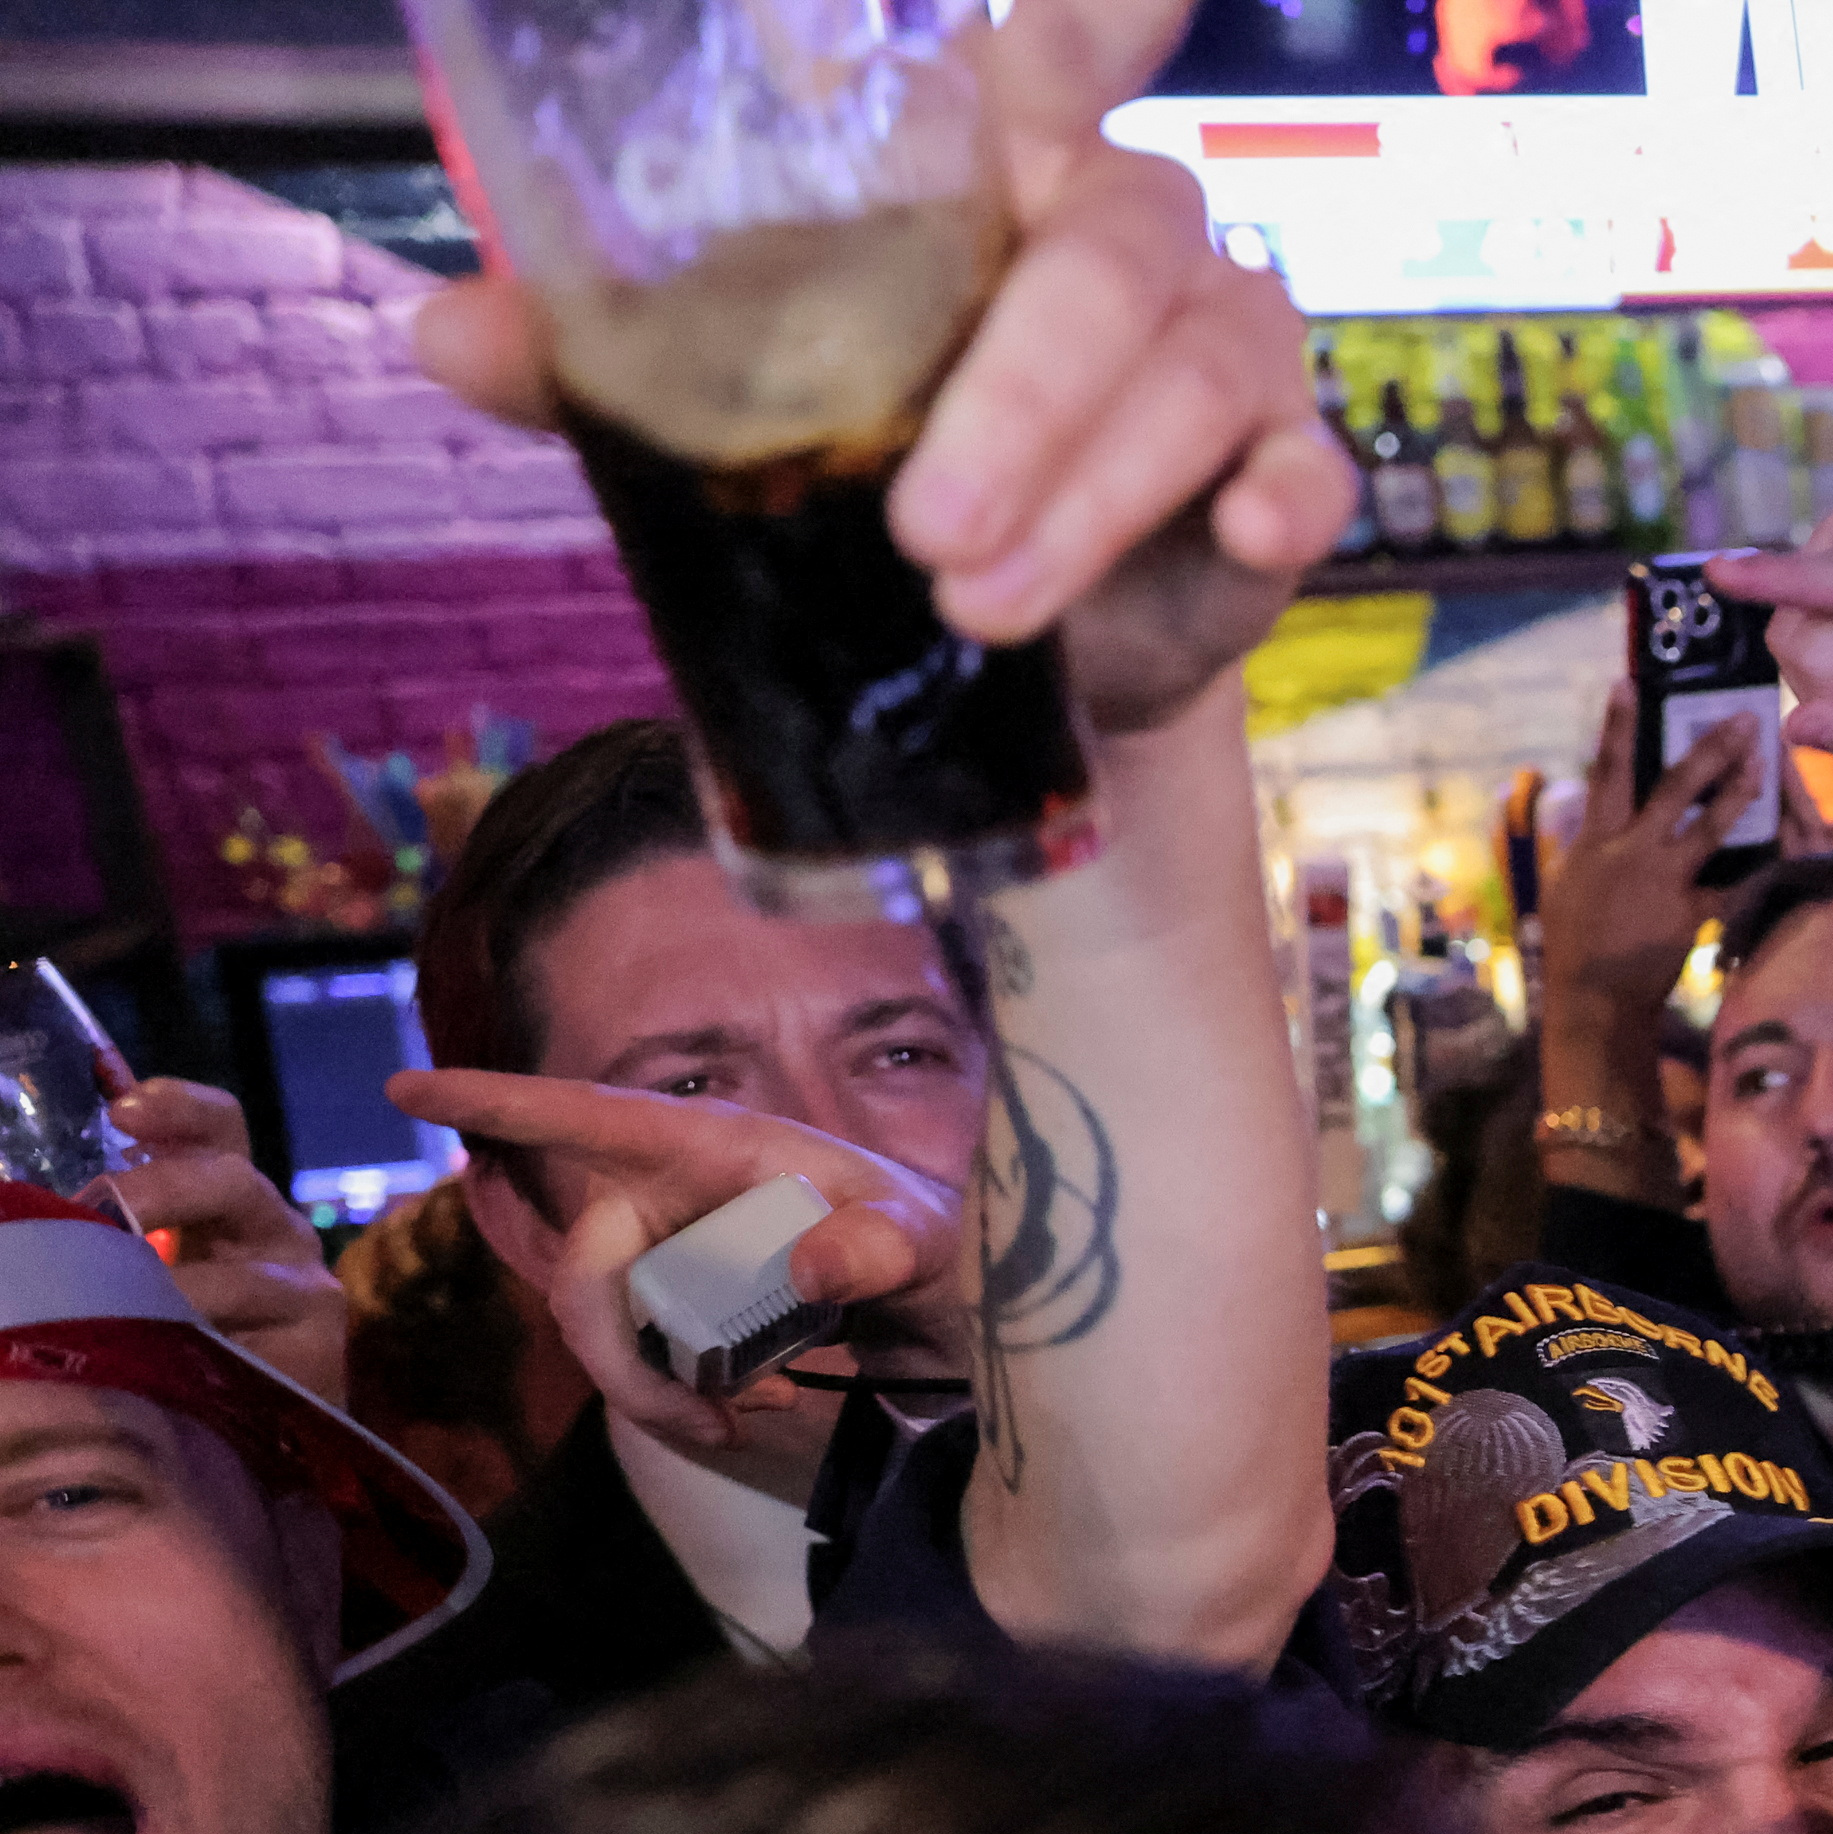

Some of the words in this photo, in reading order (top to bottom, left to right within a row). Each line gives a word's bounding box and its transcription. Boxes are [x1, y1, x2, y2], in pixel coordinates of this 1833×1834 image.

[1377, 1330, 1471, 1473] 101ST
[1472, 1282, 1780, 1412] AIRBORNE
[1515, 1451, 1811, 1546] DIVISION
